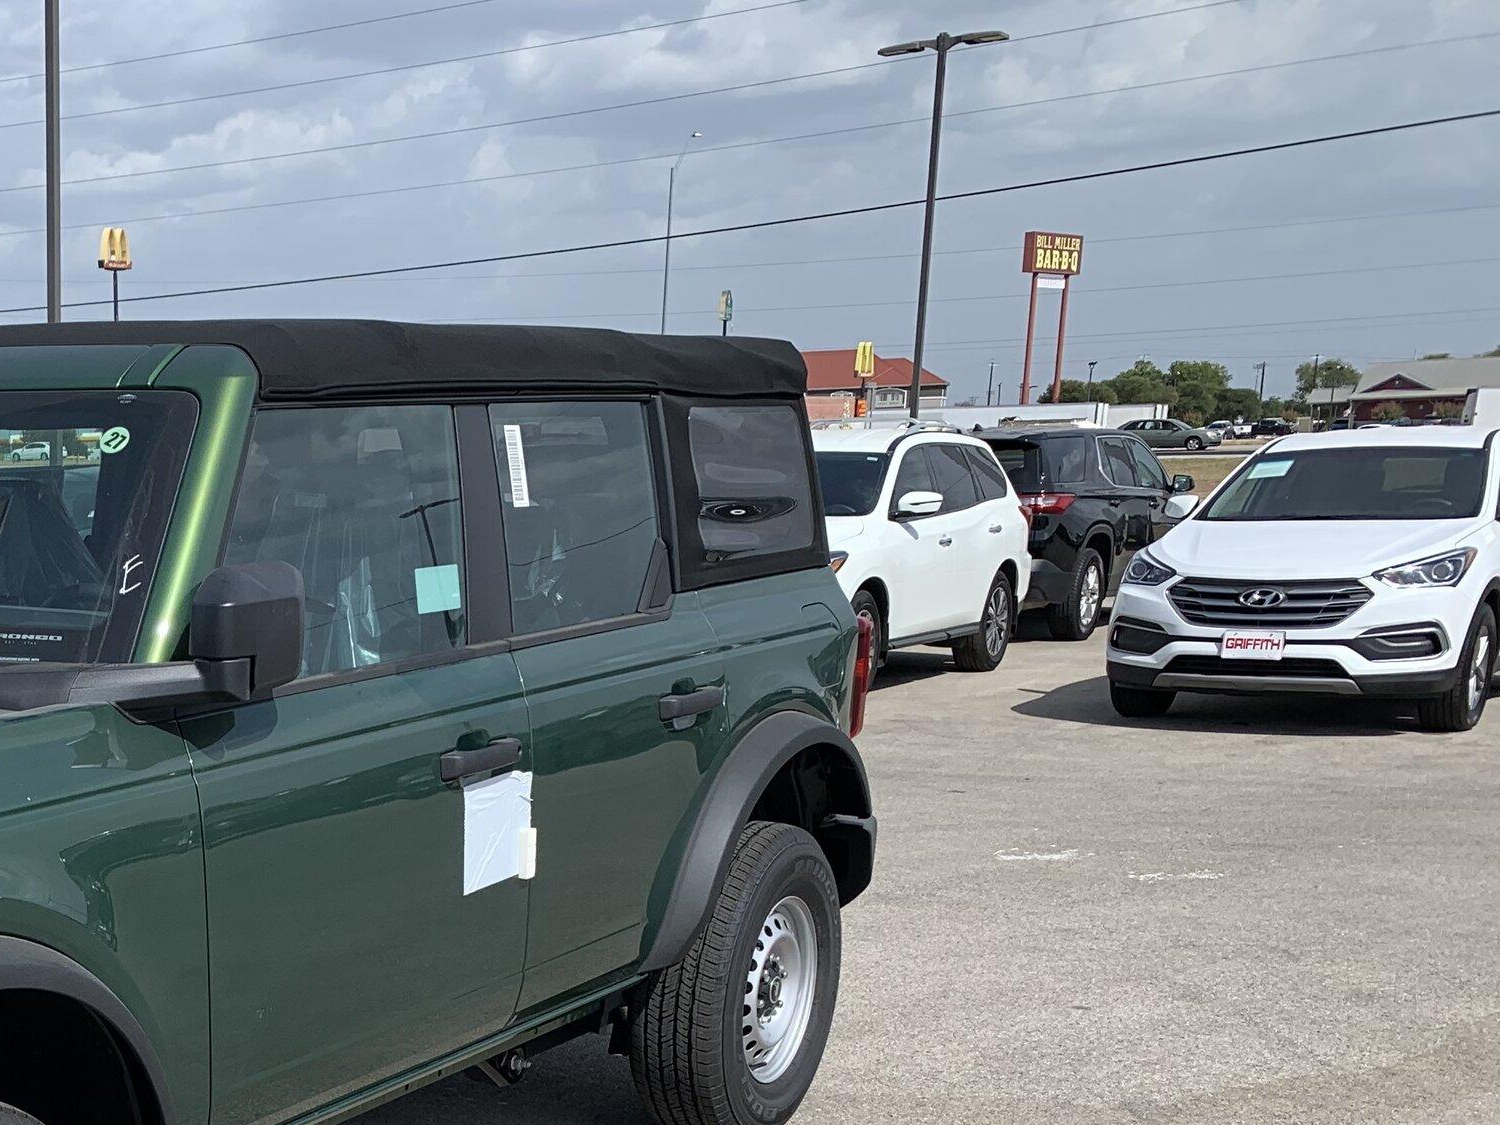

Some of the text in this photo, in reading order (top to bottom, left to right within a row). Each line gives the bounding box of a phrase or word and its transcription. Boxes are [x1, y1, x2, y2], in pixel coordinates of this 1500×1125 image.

[1036, 235, 1080, 251] BILL MILLER
[104, 431, 128, 450] 27
[1225, 637, 1280, 650] GRIFFITH
